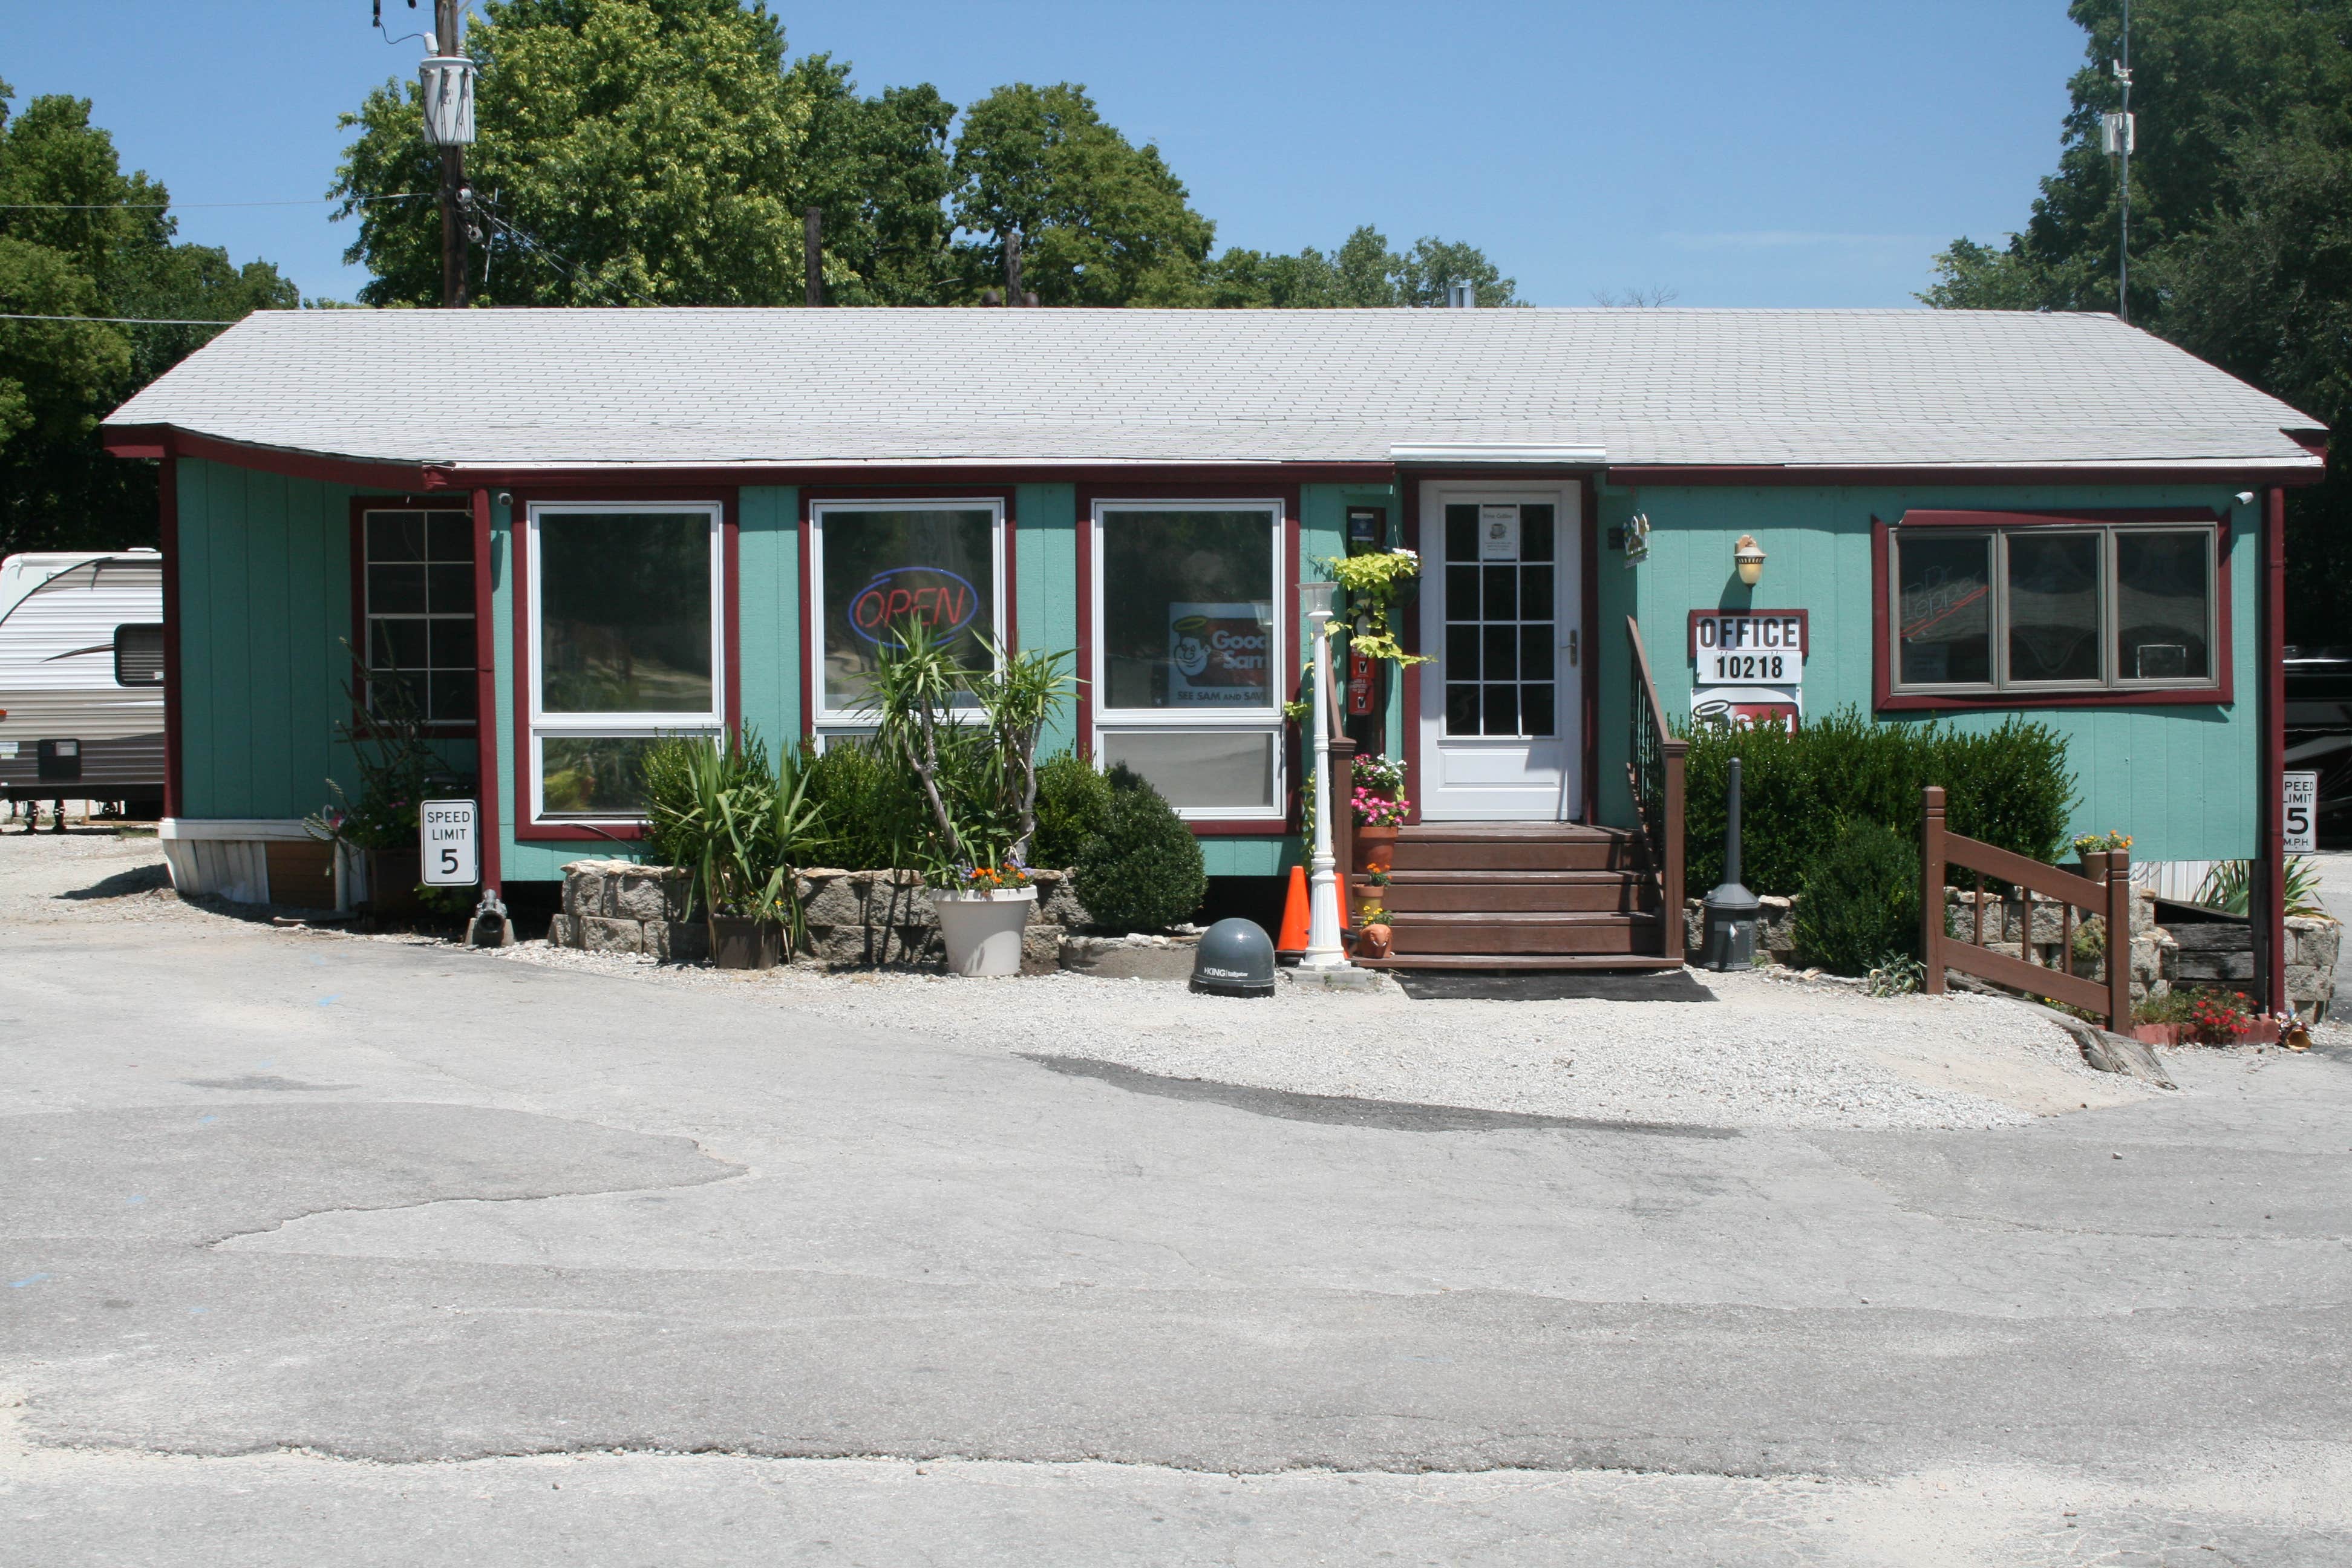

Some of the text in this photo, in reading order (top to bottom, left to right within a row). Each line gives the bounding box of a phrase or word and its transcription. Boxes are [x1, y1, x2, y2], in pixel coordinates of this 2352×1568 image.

[855, 586, 966, 629] OPEN
[1700, 618, 1797, 648] OFFICE
[1717, 656, 1783, 678] 10218
[1177, 691, 1193, 700] SEE
[1197, 691, 1220, 701] SAM
[1244, 691, 1267, 701] SAV
[2284, 781, 2314, 791] PEED
[427, 811, 471, 823] SPEED
[2286, 807, 2308, 835] 5
[432, 828, 466, 840] LIMIT
[441, 848, 459, 875] 5
[1206, 967, 1226, 977] KING
